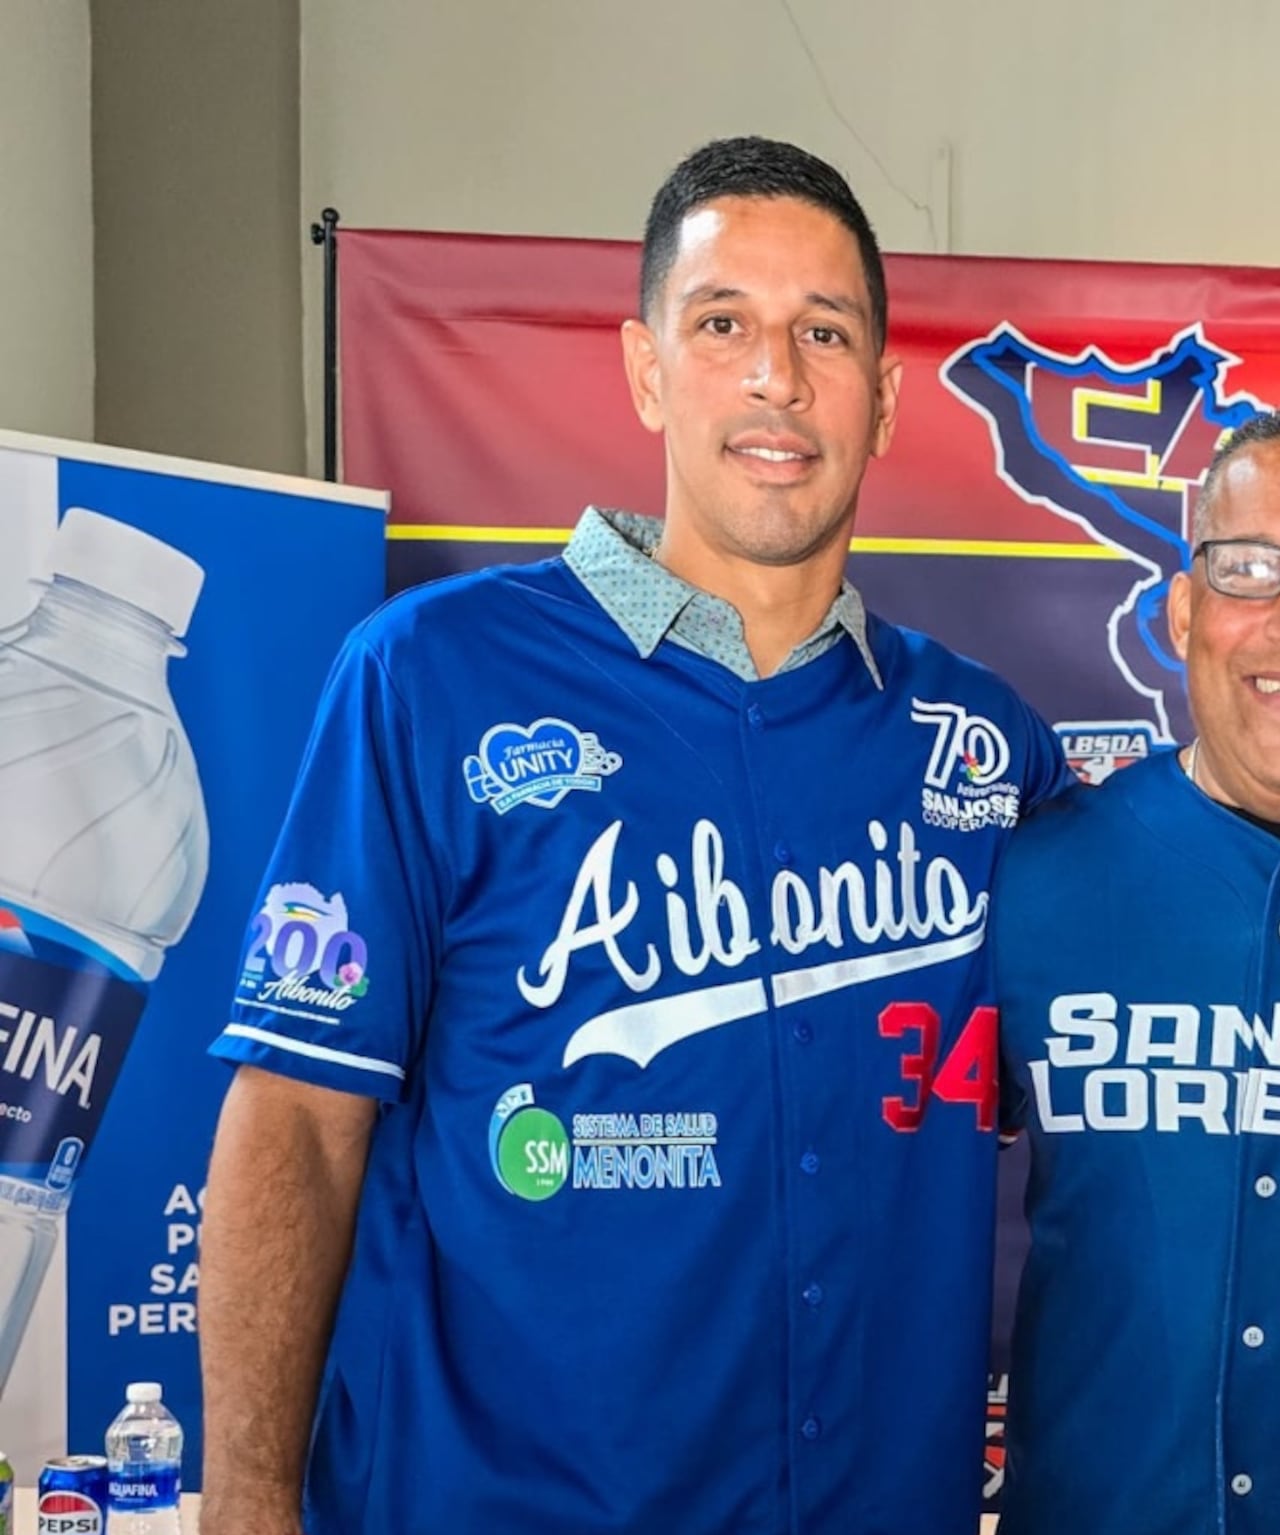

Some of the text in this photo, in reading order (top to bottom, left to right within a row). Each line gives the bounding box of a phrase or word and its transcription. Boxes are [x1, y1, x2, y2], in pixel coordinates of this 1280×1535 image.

[503, 738, 566, 760] Farmacia
[910, 697, 1010, 789] 70
[1062, 733, 1148, 754] LBSDA
[499, 747, 574, 783] UNITY
[922, 787, 959, 818] SAN
[516, 819, 990, 1008] Aibonito
[244, 912, 368, 990] 200
[879, 1001, 1000, 1133] 34
[573, 1112, 717, 1138] SISTEMA DE SALUD
[525, 1140, 568, 1181] SSM
[572, 1145, 722, 1189] MENONITA
